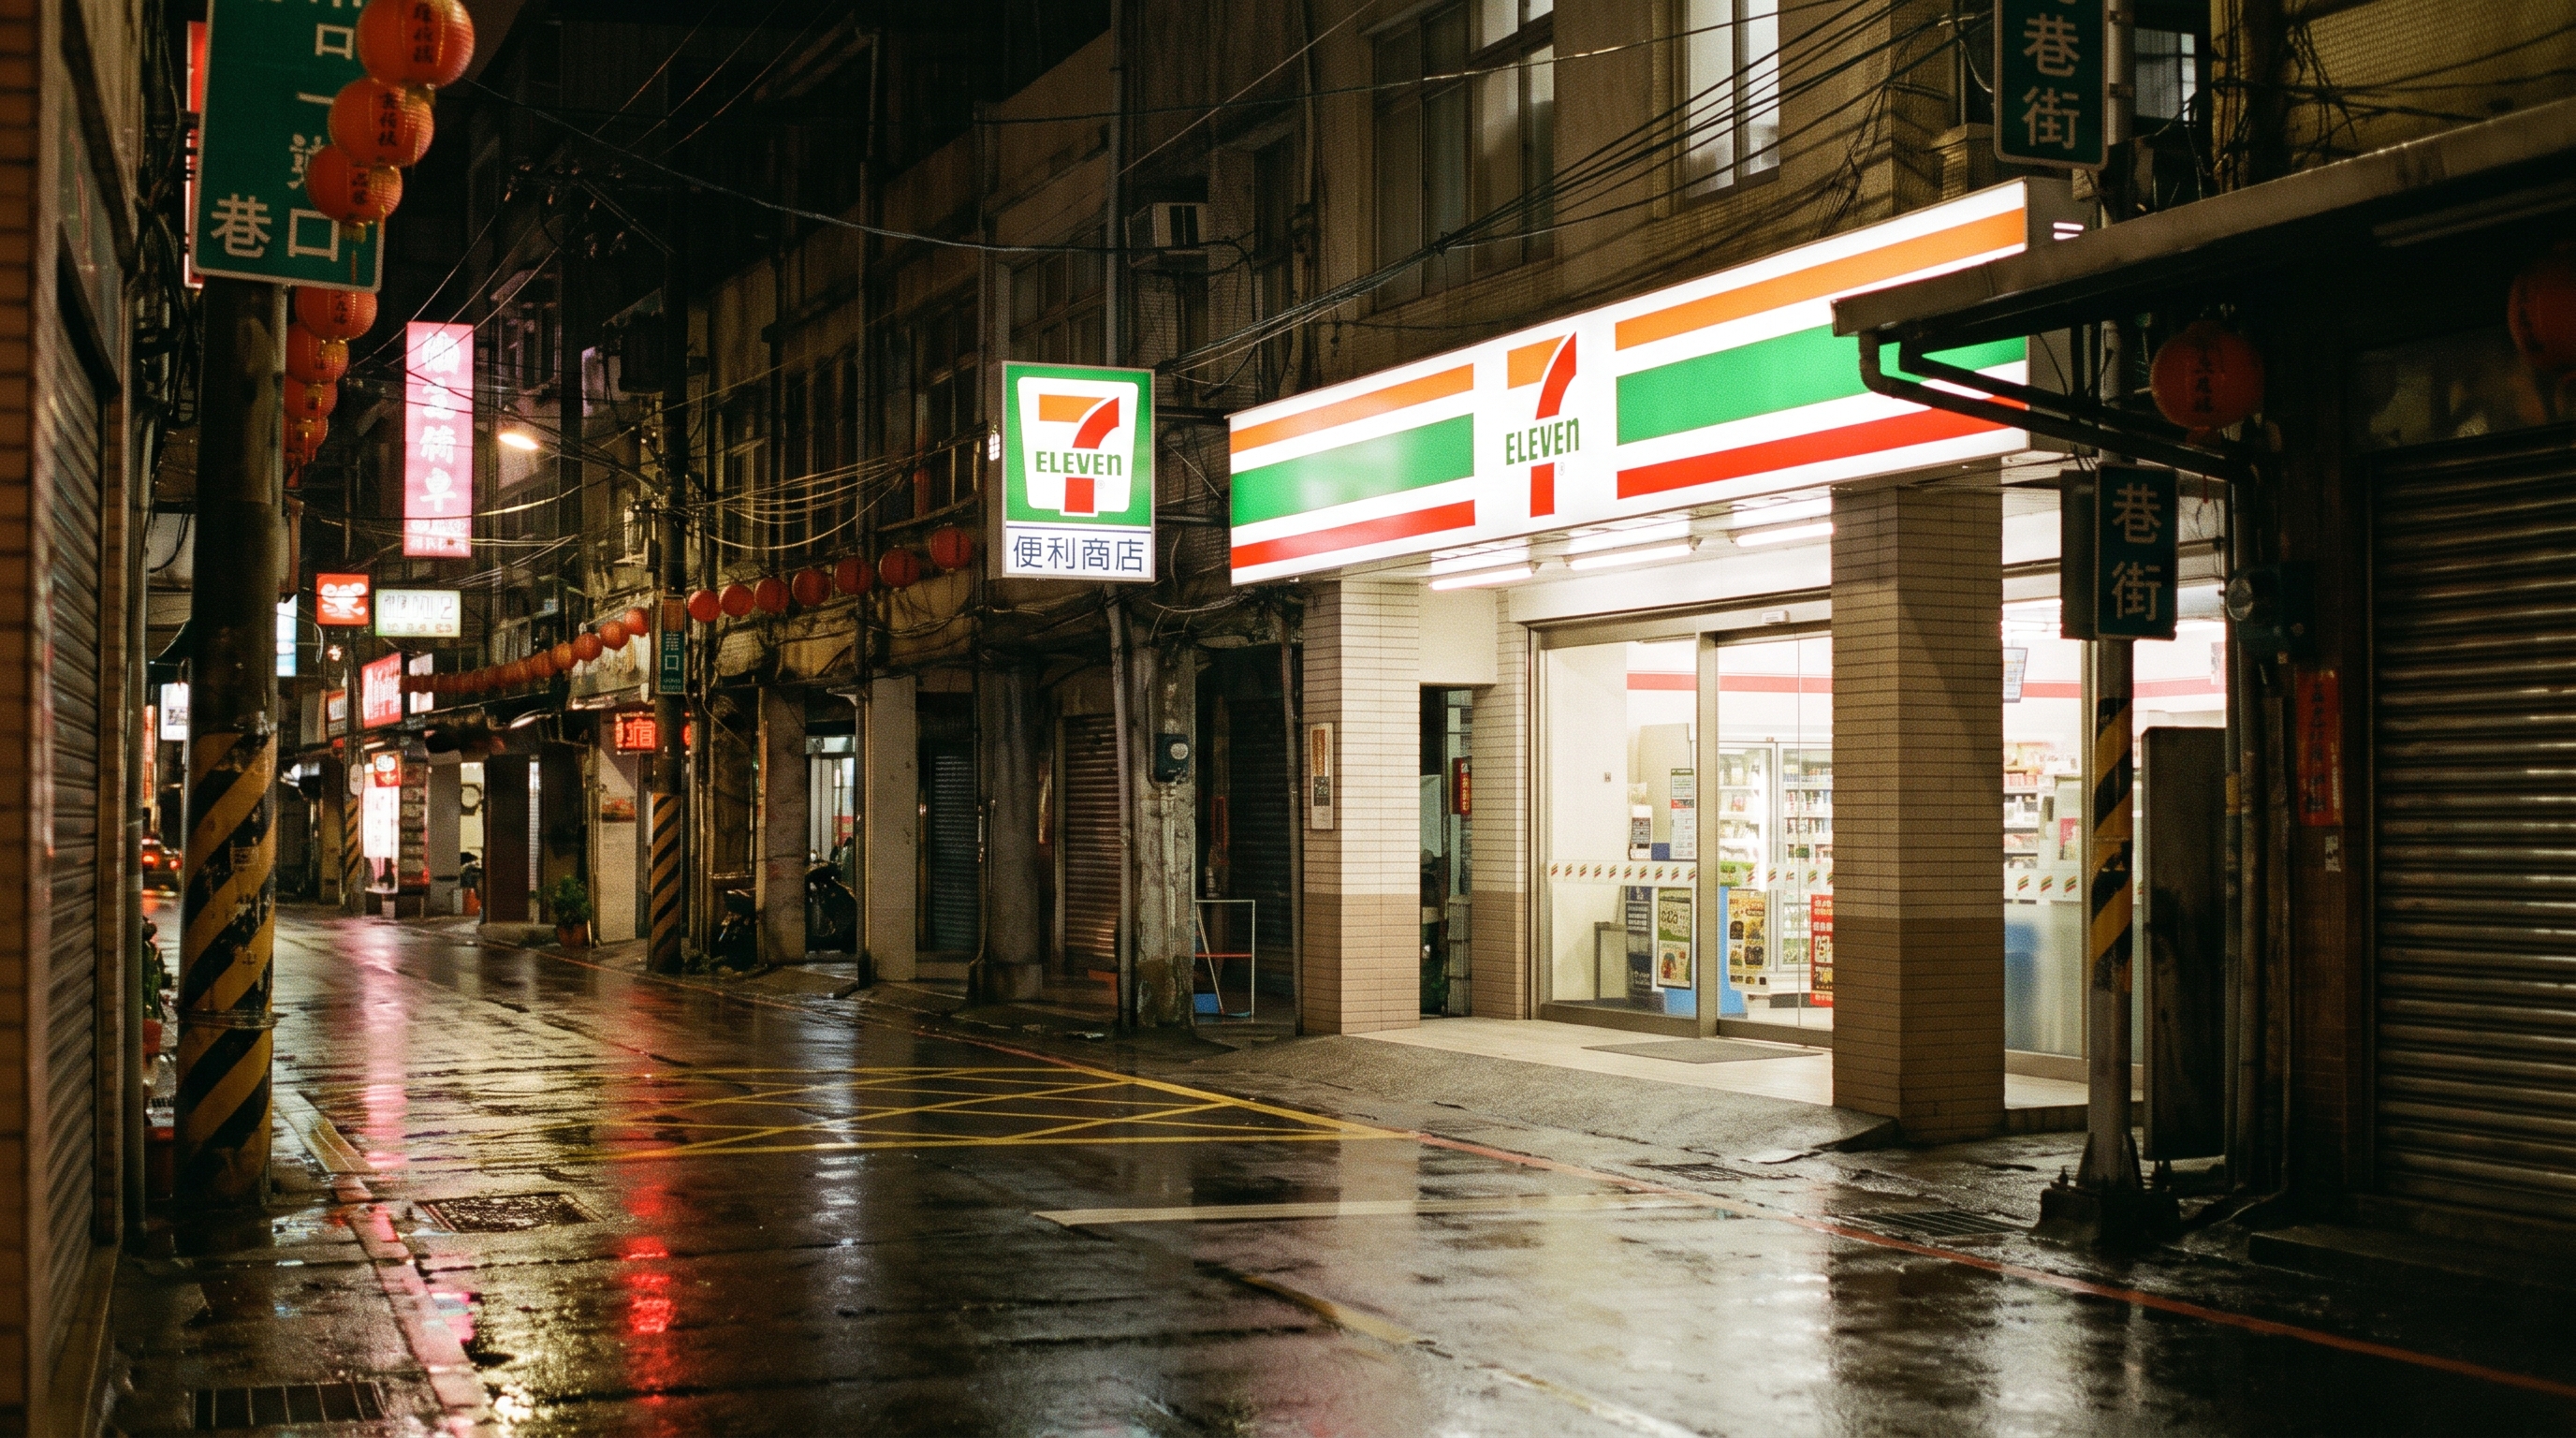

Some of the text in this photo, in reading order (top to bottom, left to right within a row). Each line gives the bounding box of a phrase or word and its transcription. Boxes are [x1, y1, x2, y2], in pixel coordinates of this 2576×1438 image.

[2022, 0, 2081, 150] 巷街
[1013, 534, 1144, 573] 便利商店
[2112, 482, 2162, 623] 巷街
